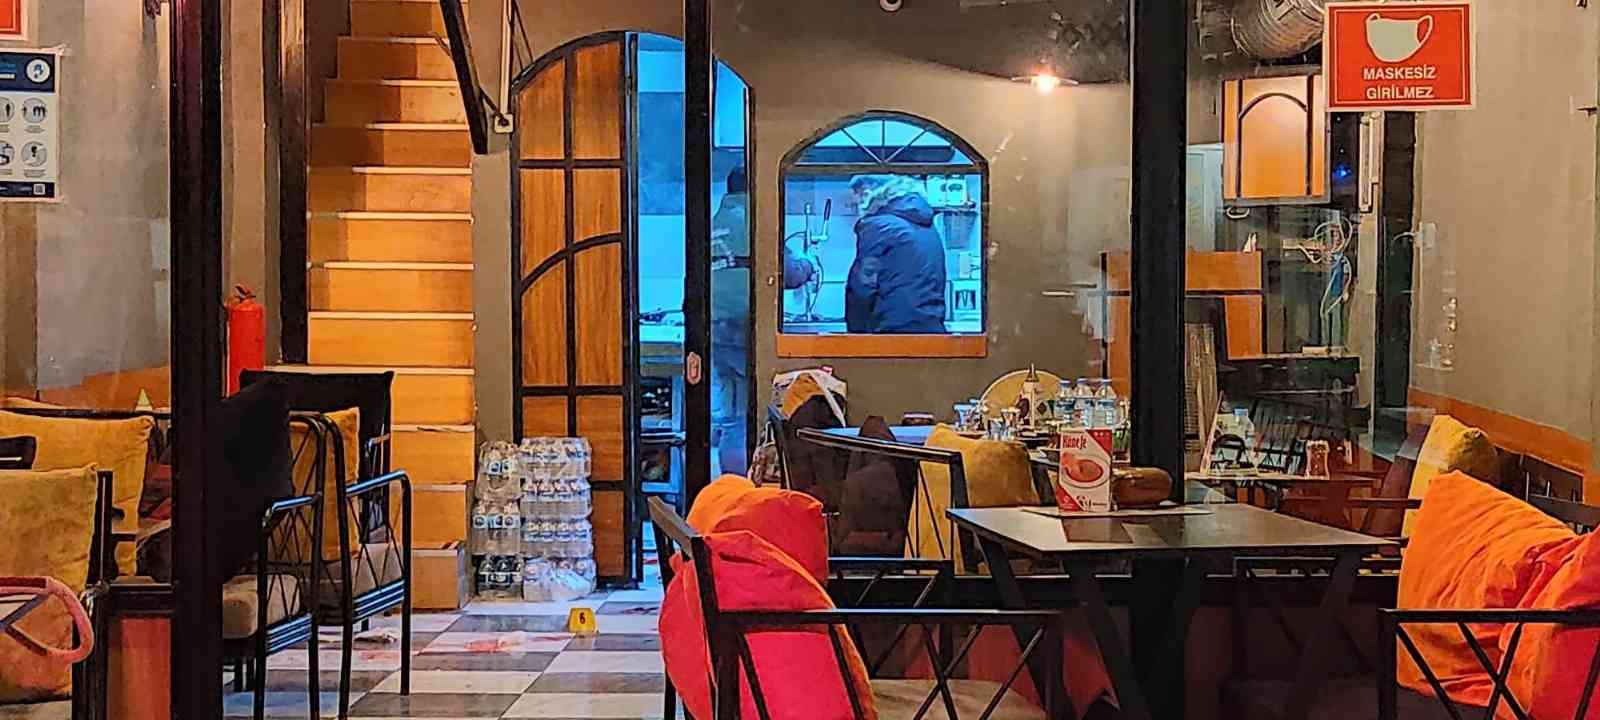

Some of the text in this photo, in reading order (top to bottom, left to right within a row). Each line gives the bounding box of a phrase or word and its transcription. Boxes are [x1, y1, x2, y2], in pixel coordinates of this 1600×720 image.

[1363, 65, 1437, 80] MASKESİZ
[1366, 85, 1435, 100] GİRİLMEZ
[579, 612, 586, 625] 6
